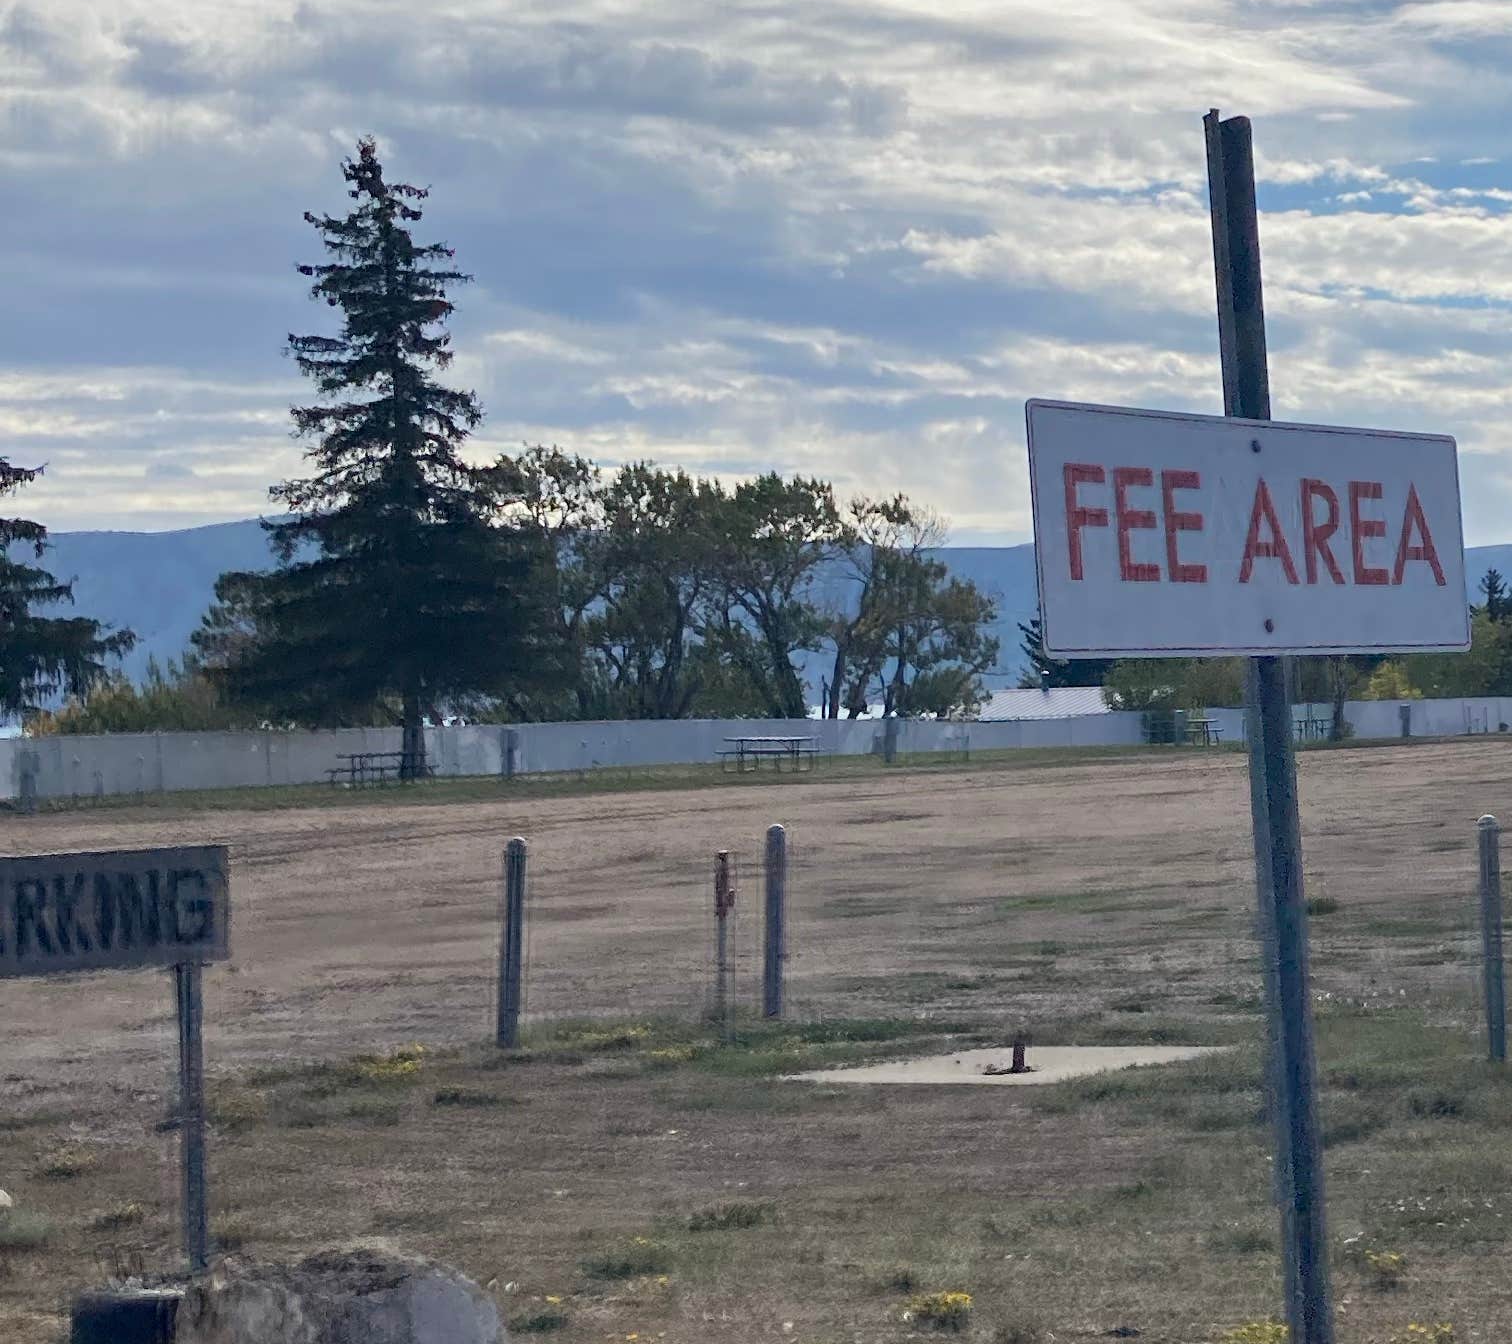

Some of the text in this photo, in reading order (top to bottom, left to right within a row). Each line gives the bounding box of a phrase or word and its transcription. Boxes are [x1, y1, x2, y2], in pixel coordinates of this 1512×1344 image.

[1063, 462, 1447, 586] FEE AREA
[0, 868, 215, 957] RKING
